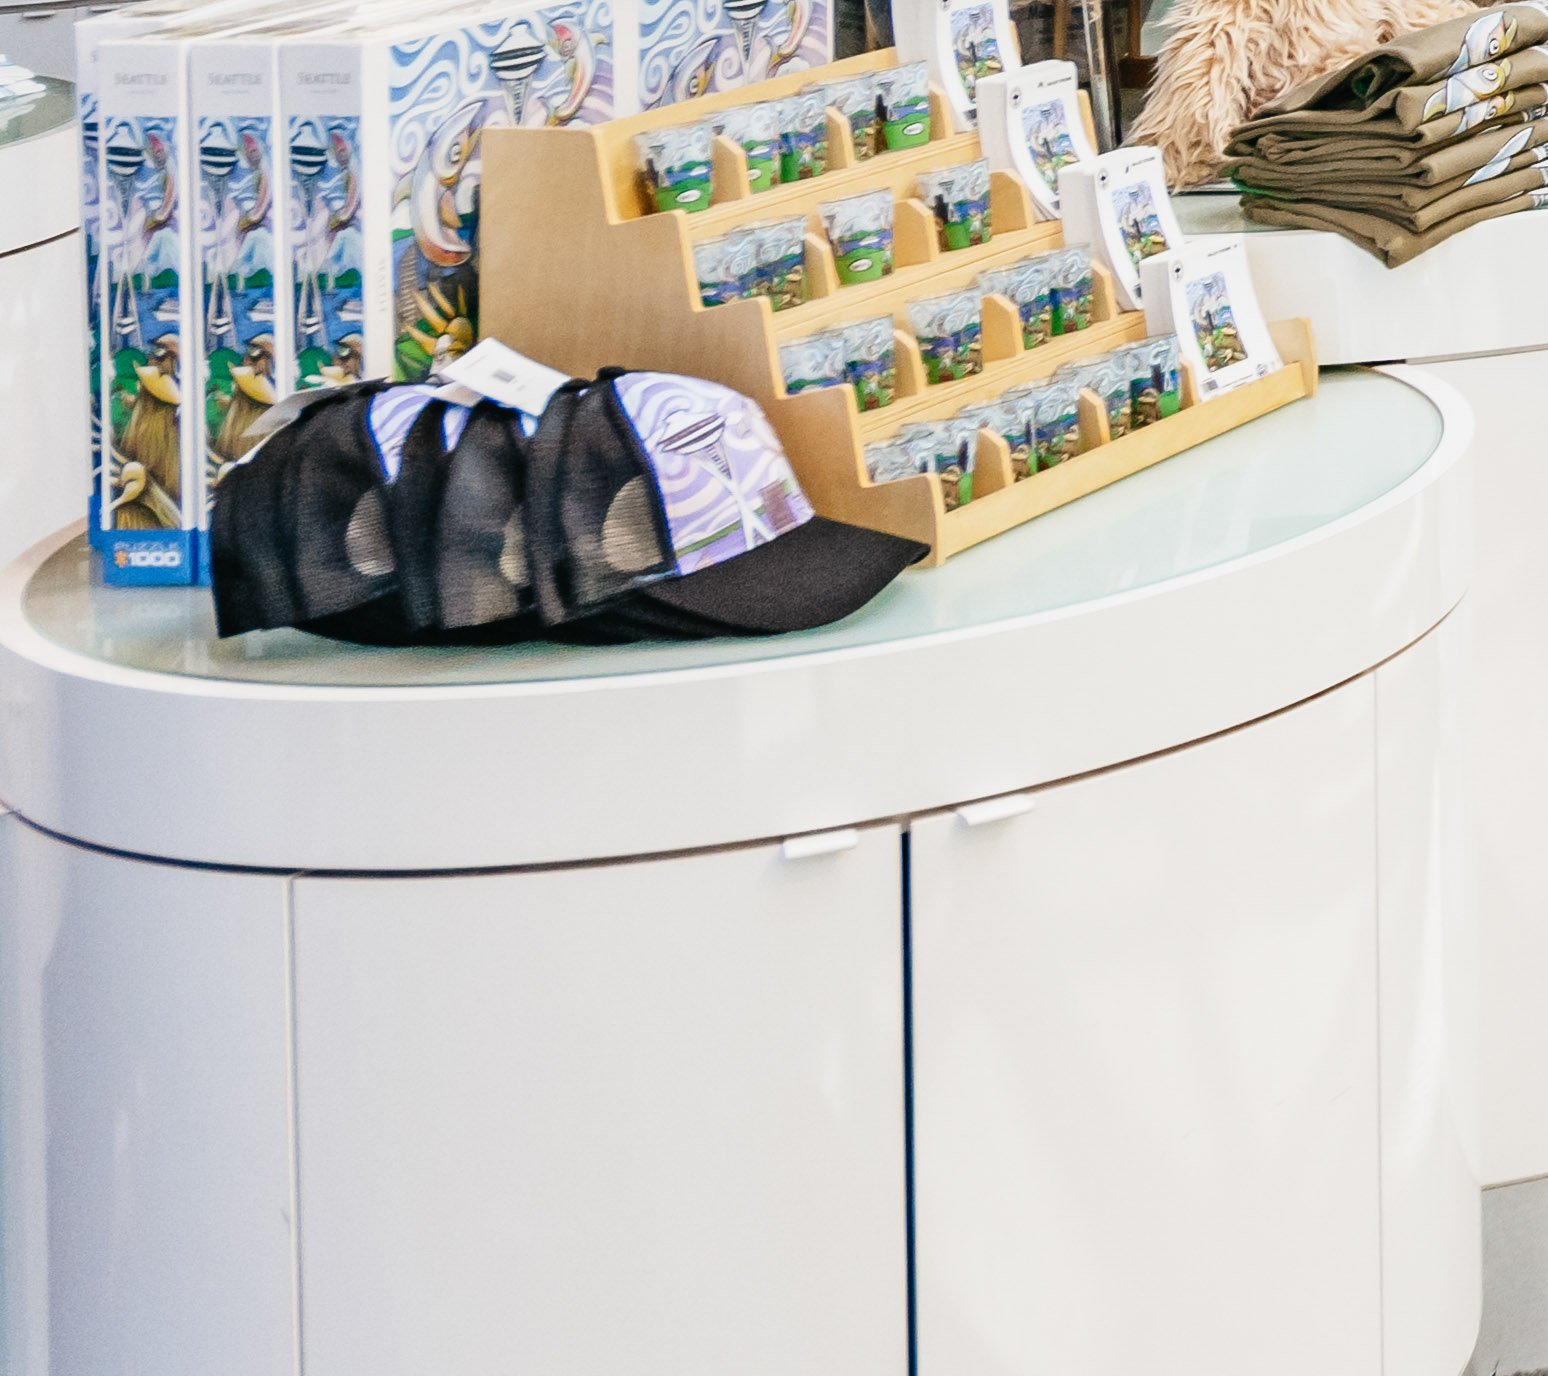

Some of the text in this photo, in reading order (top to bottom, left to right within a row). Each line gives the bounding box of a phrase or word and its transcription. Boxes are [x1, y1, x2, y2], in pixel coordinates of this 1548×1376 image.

[114, 72, 168, 86] SEATTLE
[207, 71, 264, 86] SEATTLE
[297, 71, 352, 86] SEATTLE
[128, 550, 181, 567] 1000
